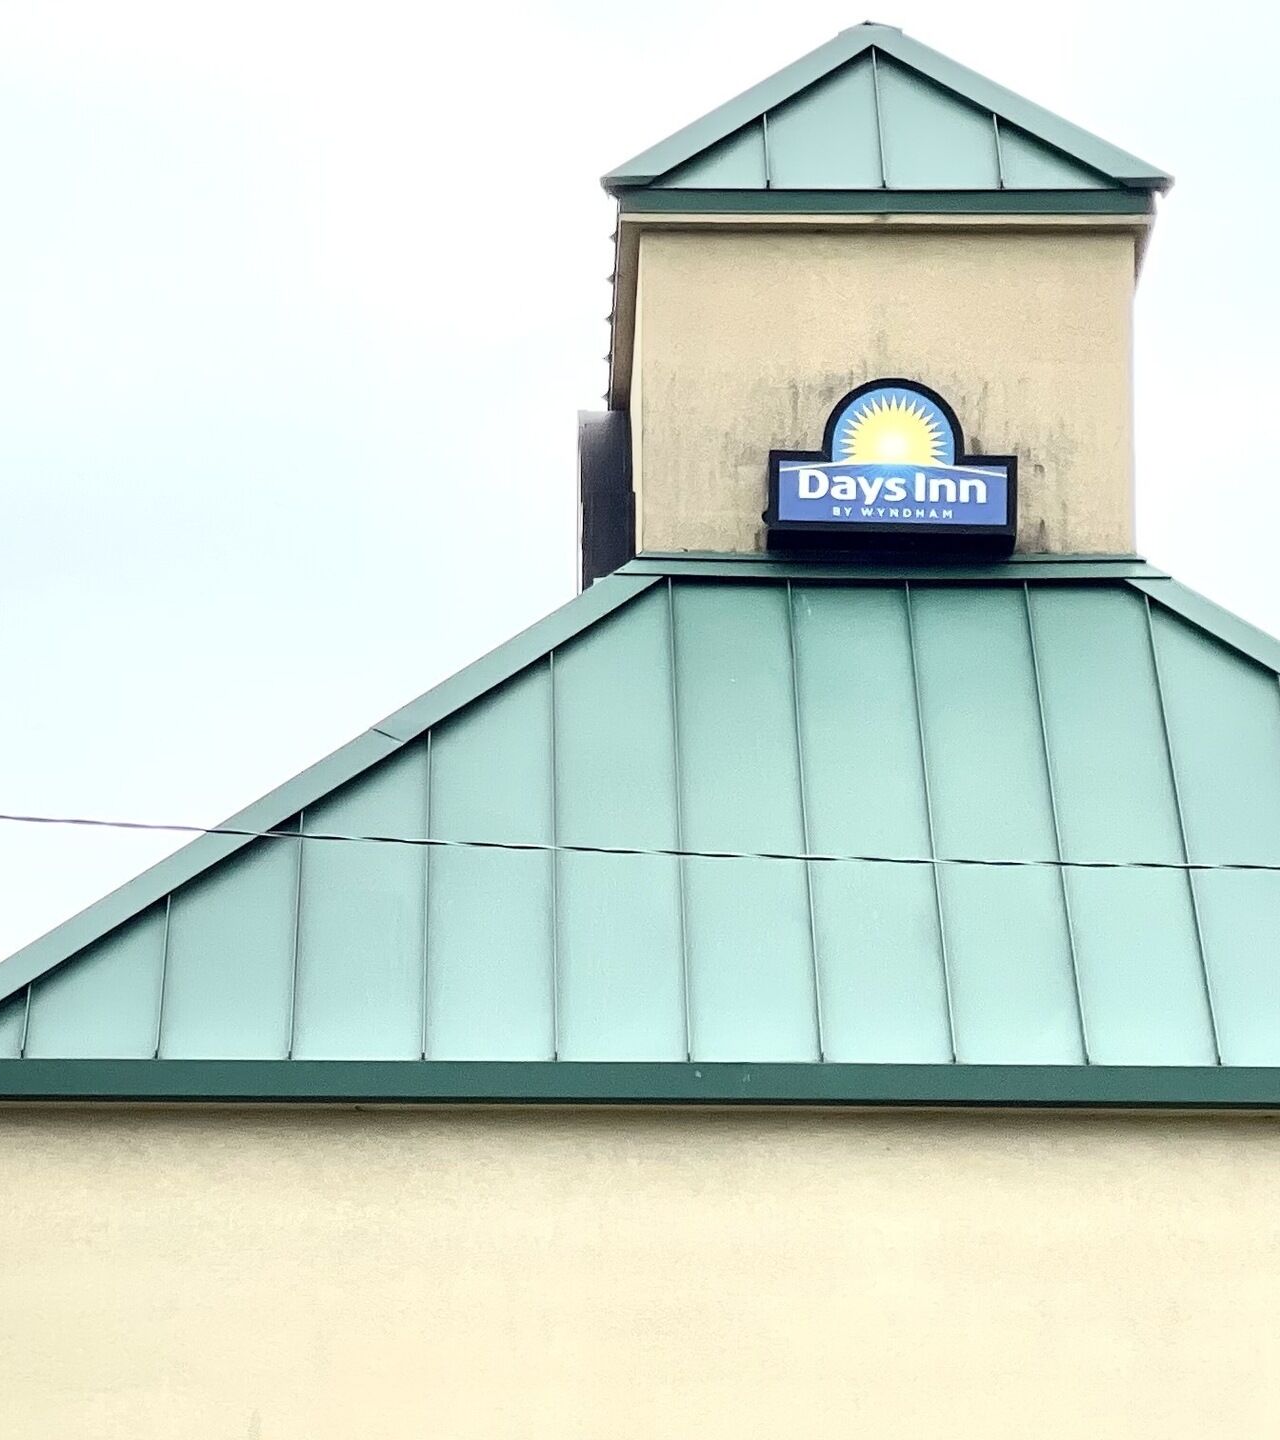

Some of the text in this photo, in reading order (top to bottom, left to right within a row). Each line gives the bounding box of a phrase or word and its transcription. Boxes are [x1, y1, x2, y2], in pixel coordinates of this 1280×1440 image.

[798, 469, 987, 505] Days Inn
[832, 506, 953, 519] BY WYNDHAM
